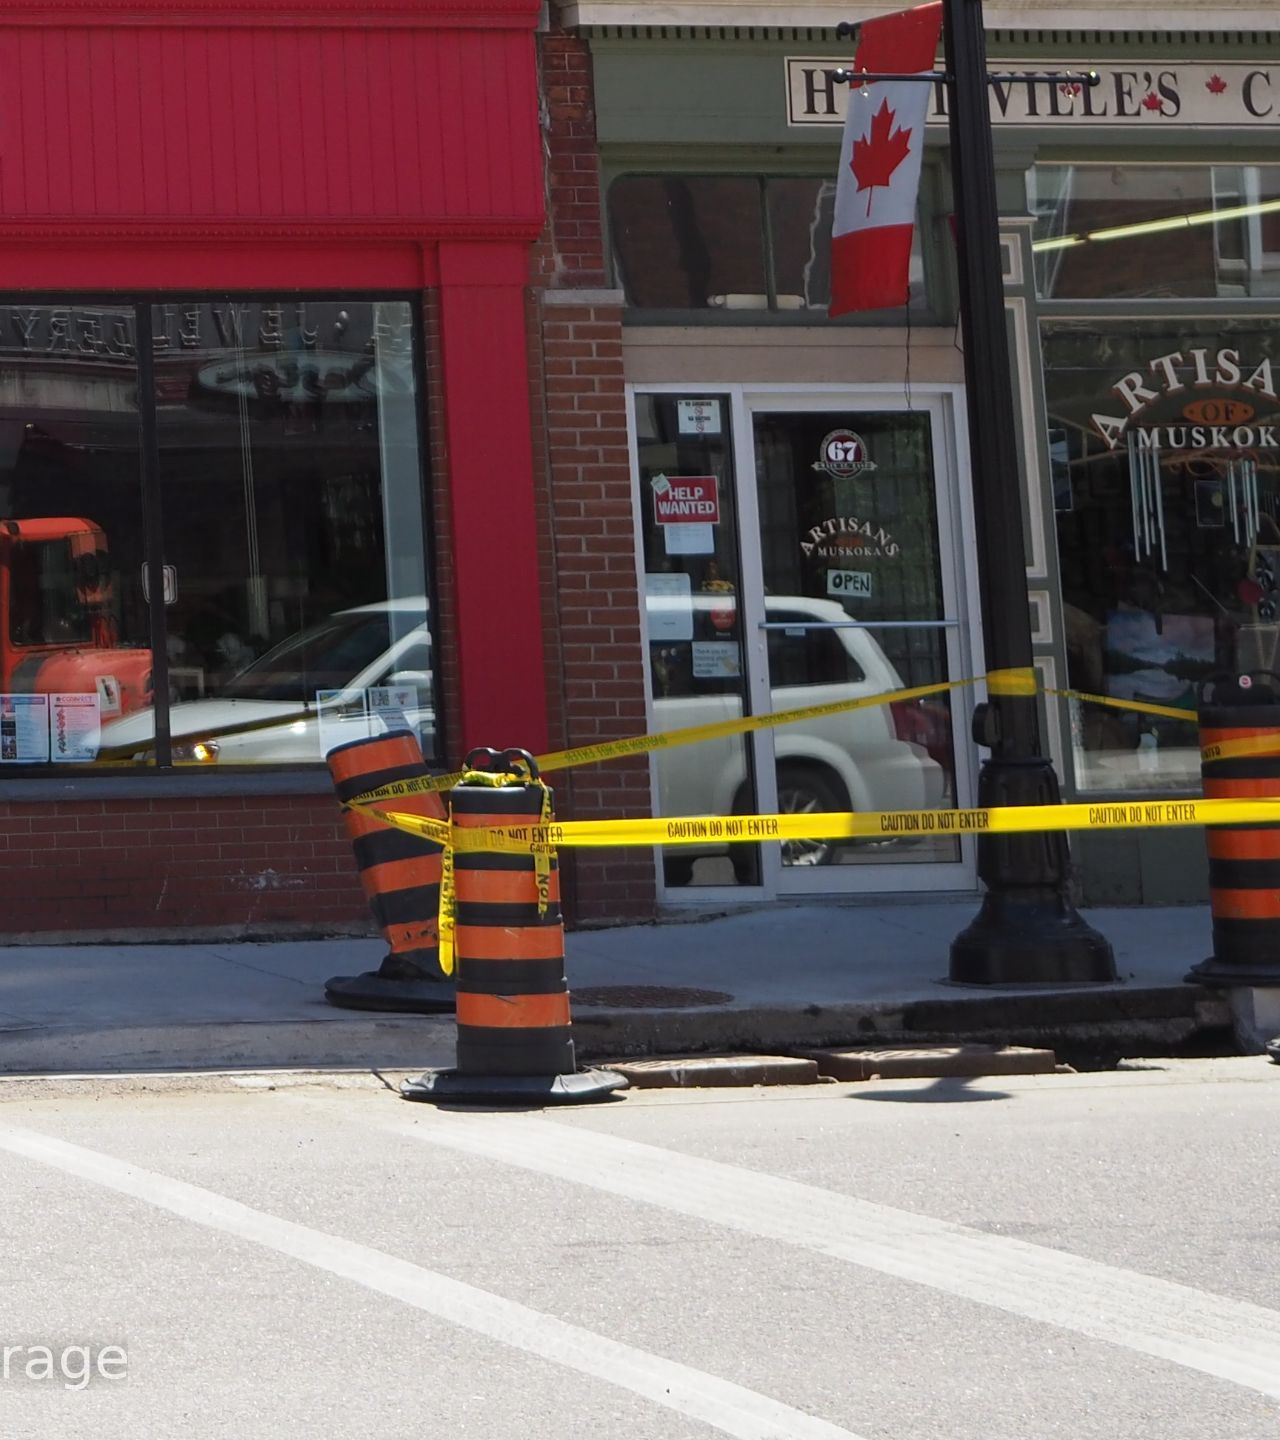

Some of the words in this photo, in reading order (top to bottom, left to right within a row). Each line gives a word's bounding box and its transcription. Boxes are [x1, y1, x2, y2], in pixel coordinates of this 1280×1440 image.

[801, 67, 1181, 118] HVILLE'S
[1201, 400, 1236, 422] OF
[827, 440, 858, 462] 67
[668, 487, 704, 500] HELP
[658, 500, 716, 515] WANTED
[799, 517, 900, 557] ARTISANS
[817, 546, 882, 557] MUSKOKA
[831, 572, 870, 592] OPEN
[392, 783, 404, 795] DO
[880, 814, 919, 832] CAUTION
[922, 814, 935, 830] DO
[937, 813, 955, 829] NOT
[959, 812, 989, 828] ENTER
[1089, 807, 1127, 824] CAUTION
[1129, 806, 1142, 822] DO
[1145, 805, 1162, 821] NOT
[1166, 804, 1195, 820] ENTER
[531, 826, 563, 843] ENTER
[667, 821, 707, 838] CAUTION
[709, 821, 722, 837] DO
[726, 820, 744, 836] NOT
[747, 818, 778, 836] ENTER
